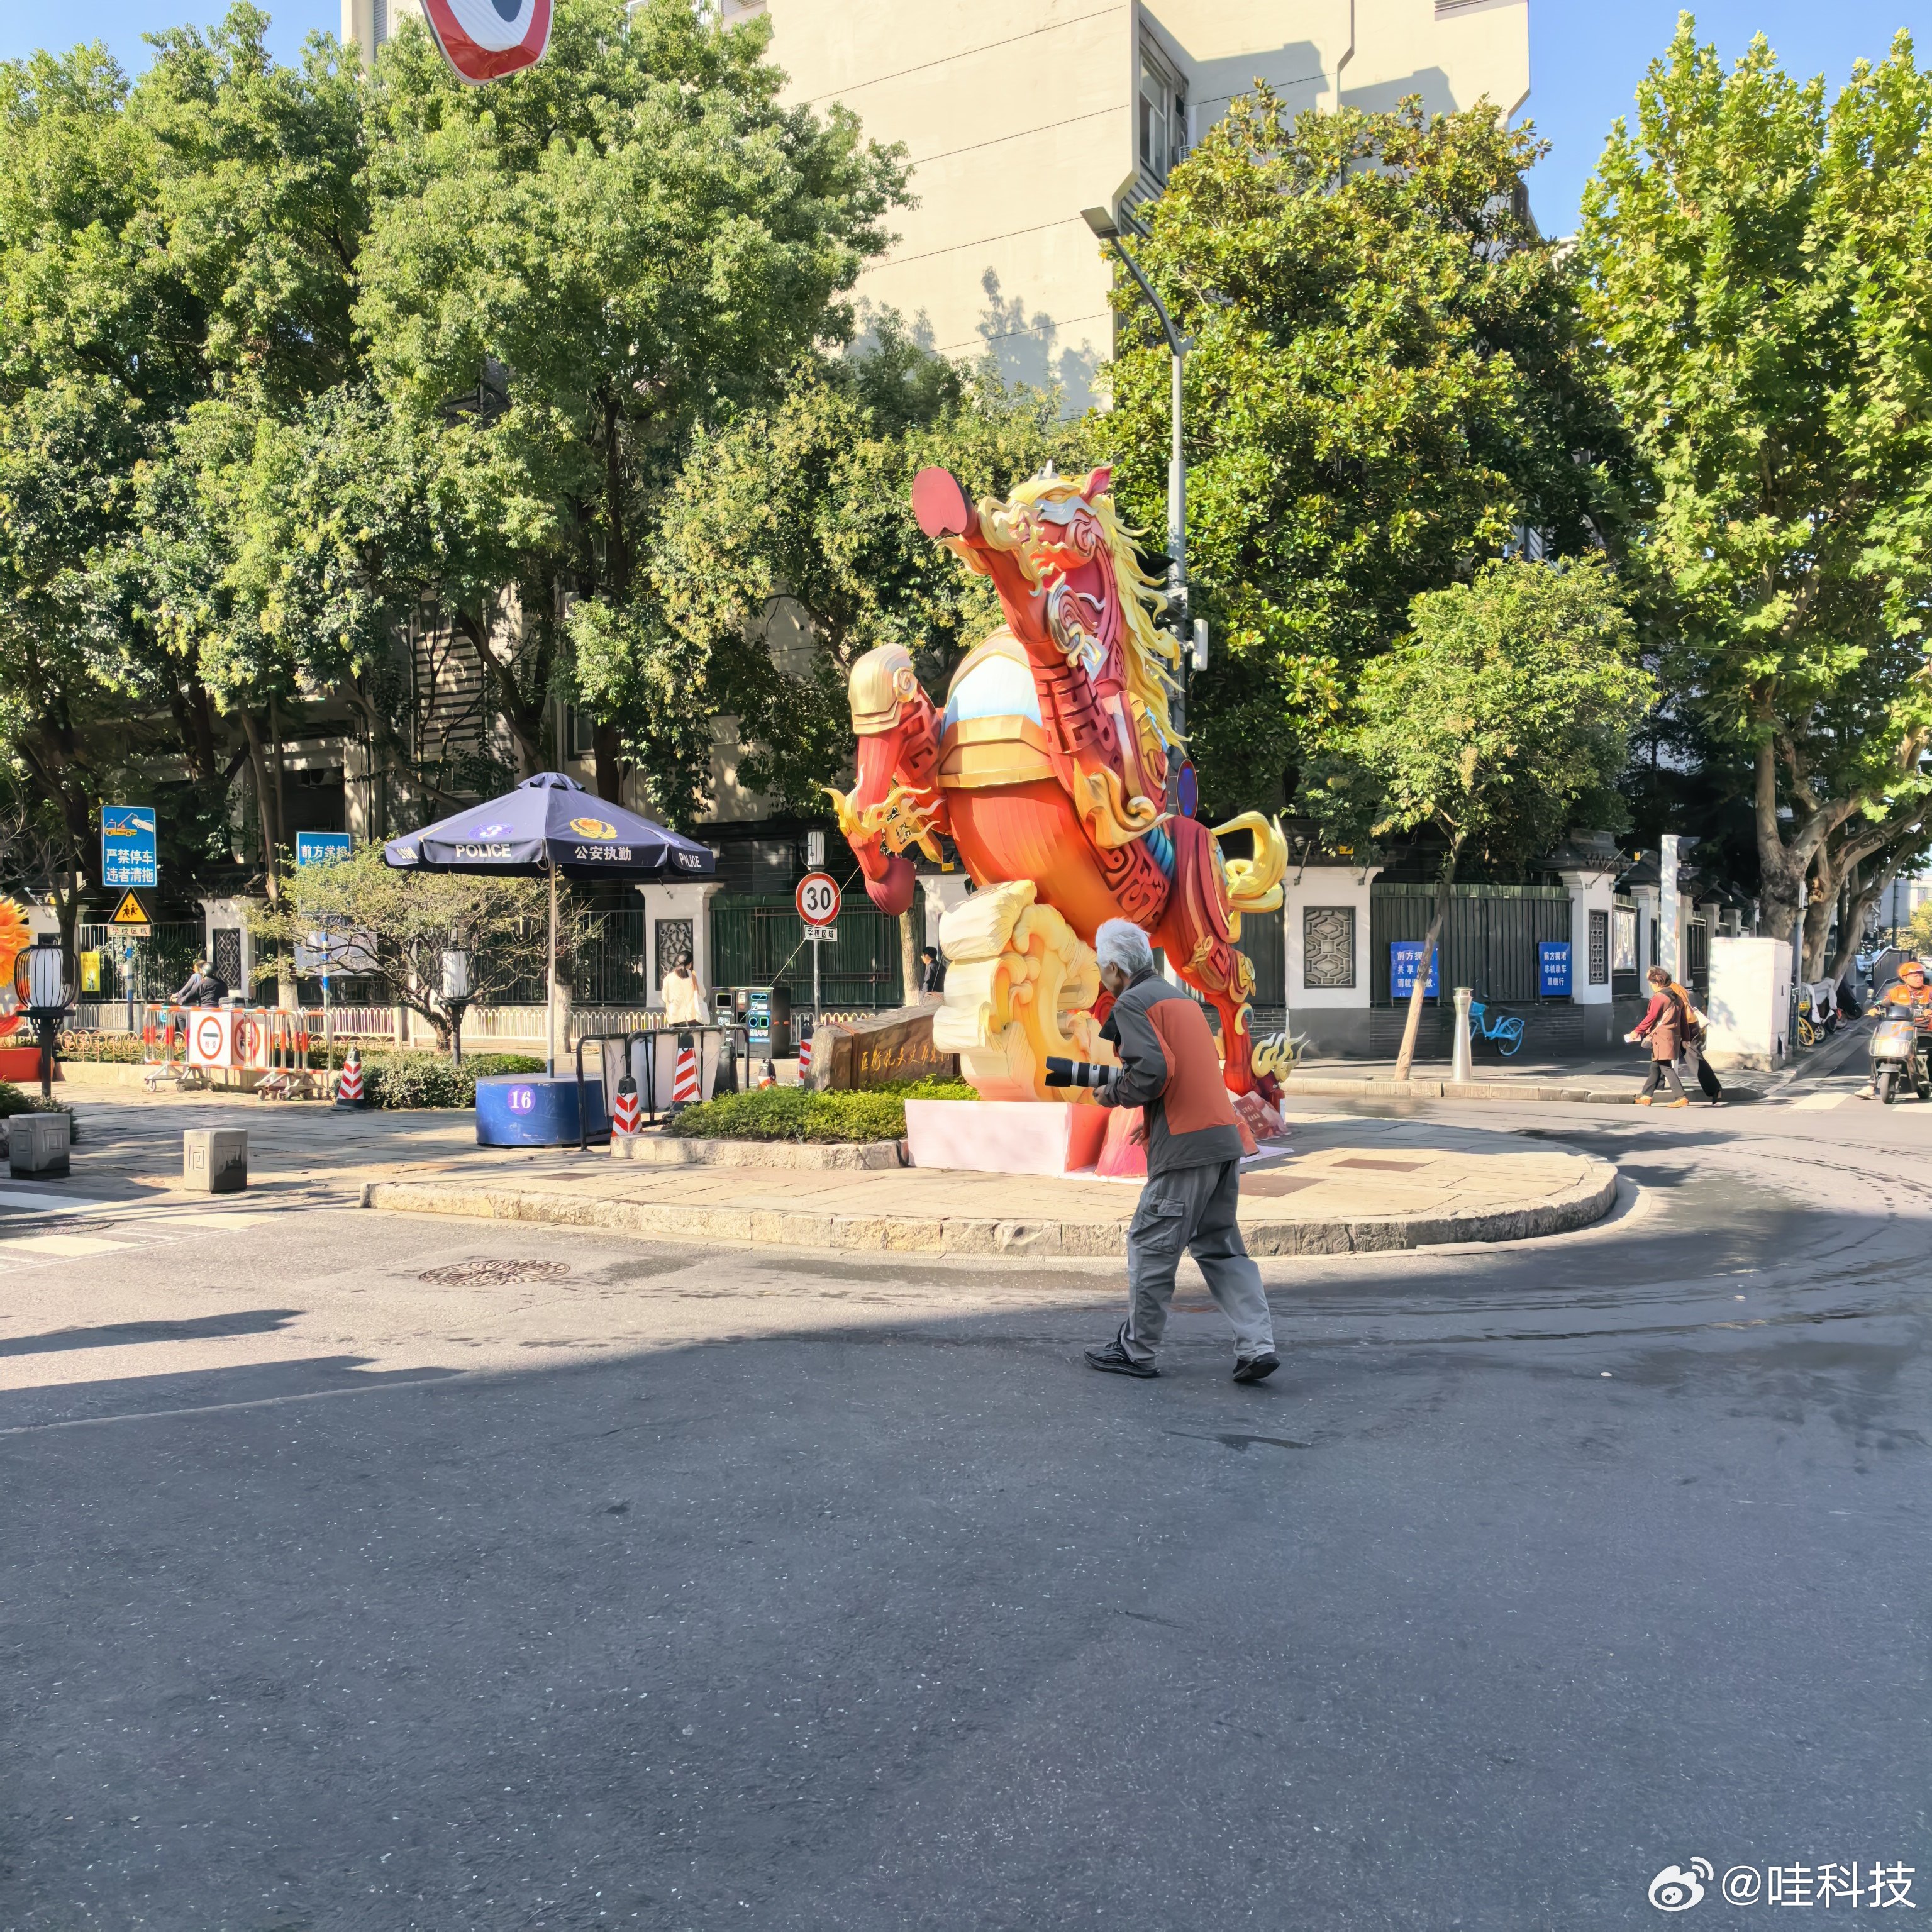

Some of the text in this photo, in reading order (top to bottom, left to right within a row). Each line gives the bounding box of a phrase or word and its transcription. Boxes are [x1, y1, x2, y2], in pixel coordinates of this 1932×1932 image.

[106, 848, 153, 865] 严禁停车
[456, 843, 511, 857] POLICE
[574, 846, 631, 861] 公安执勤
[106, 867, 153, 883] 违者清拖
[807, 887, 831, 911] 30
[808, 928, 834, 938] 学校区域
[511, 1091, 531, 1109] 16
